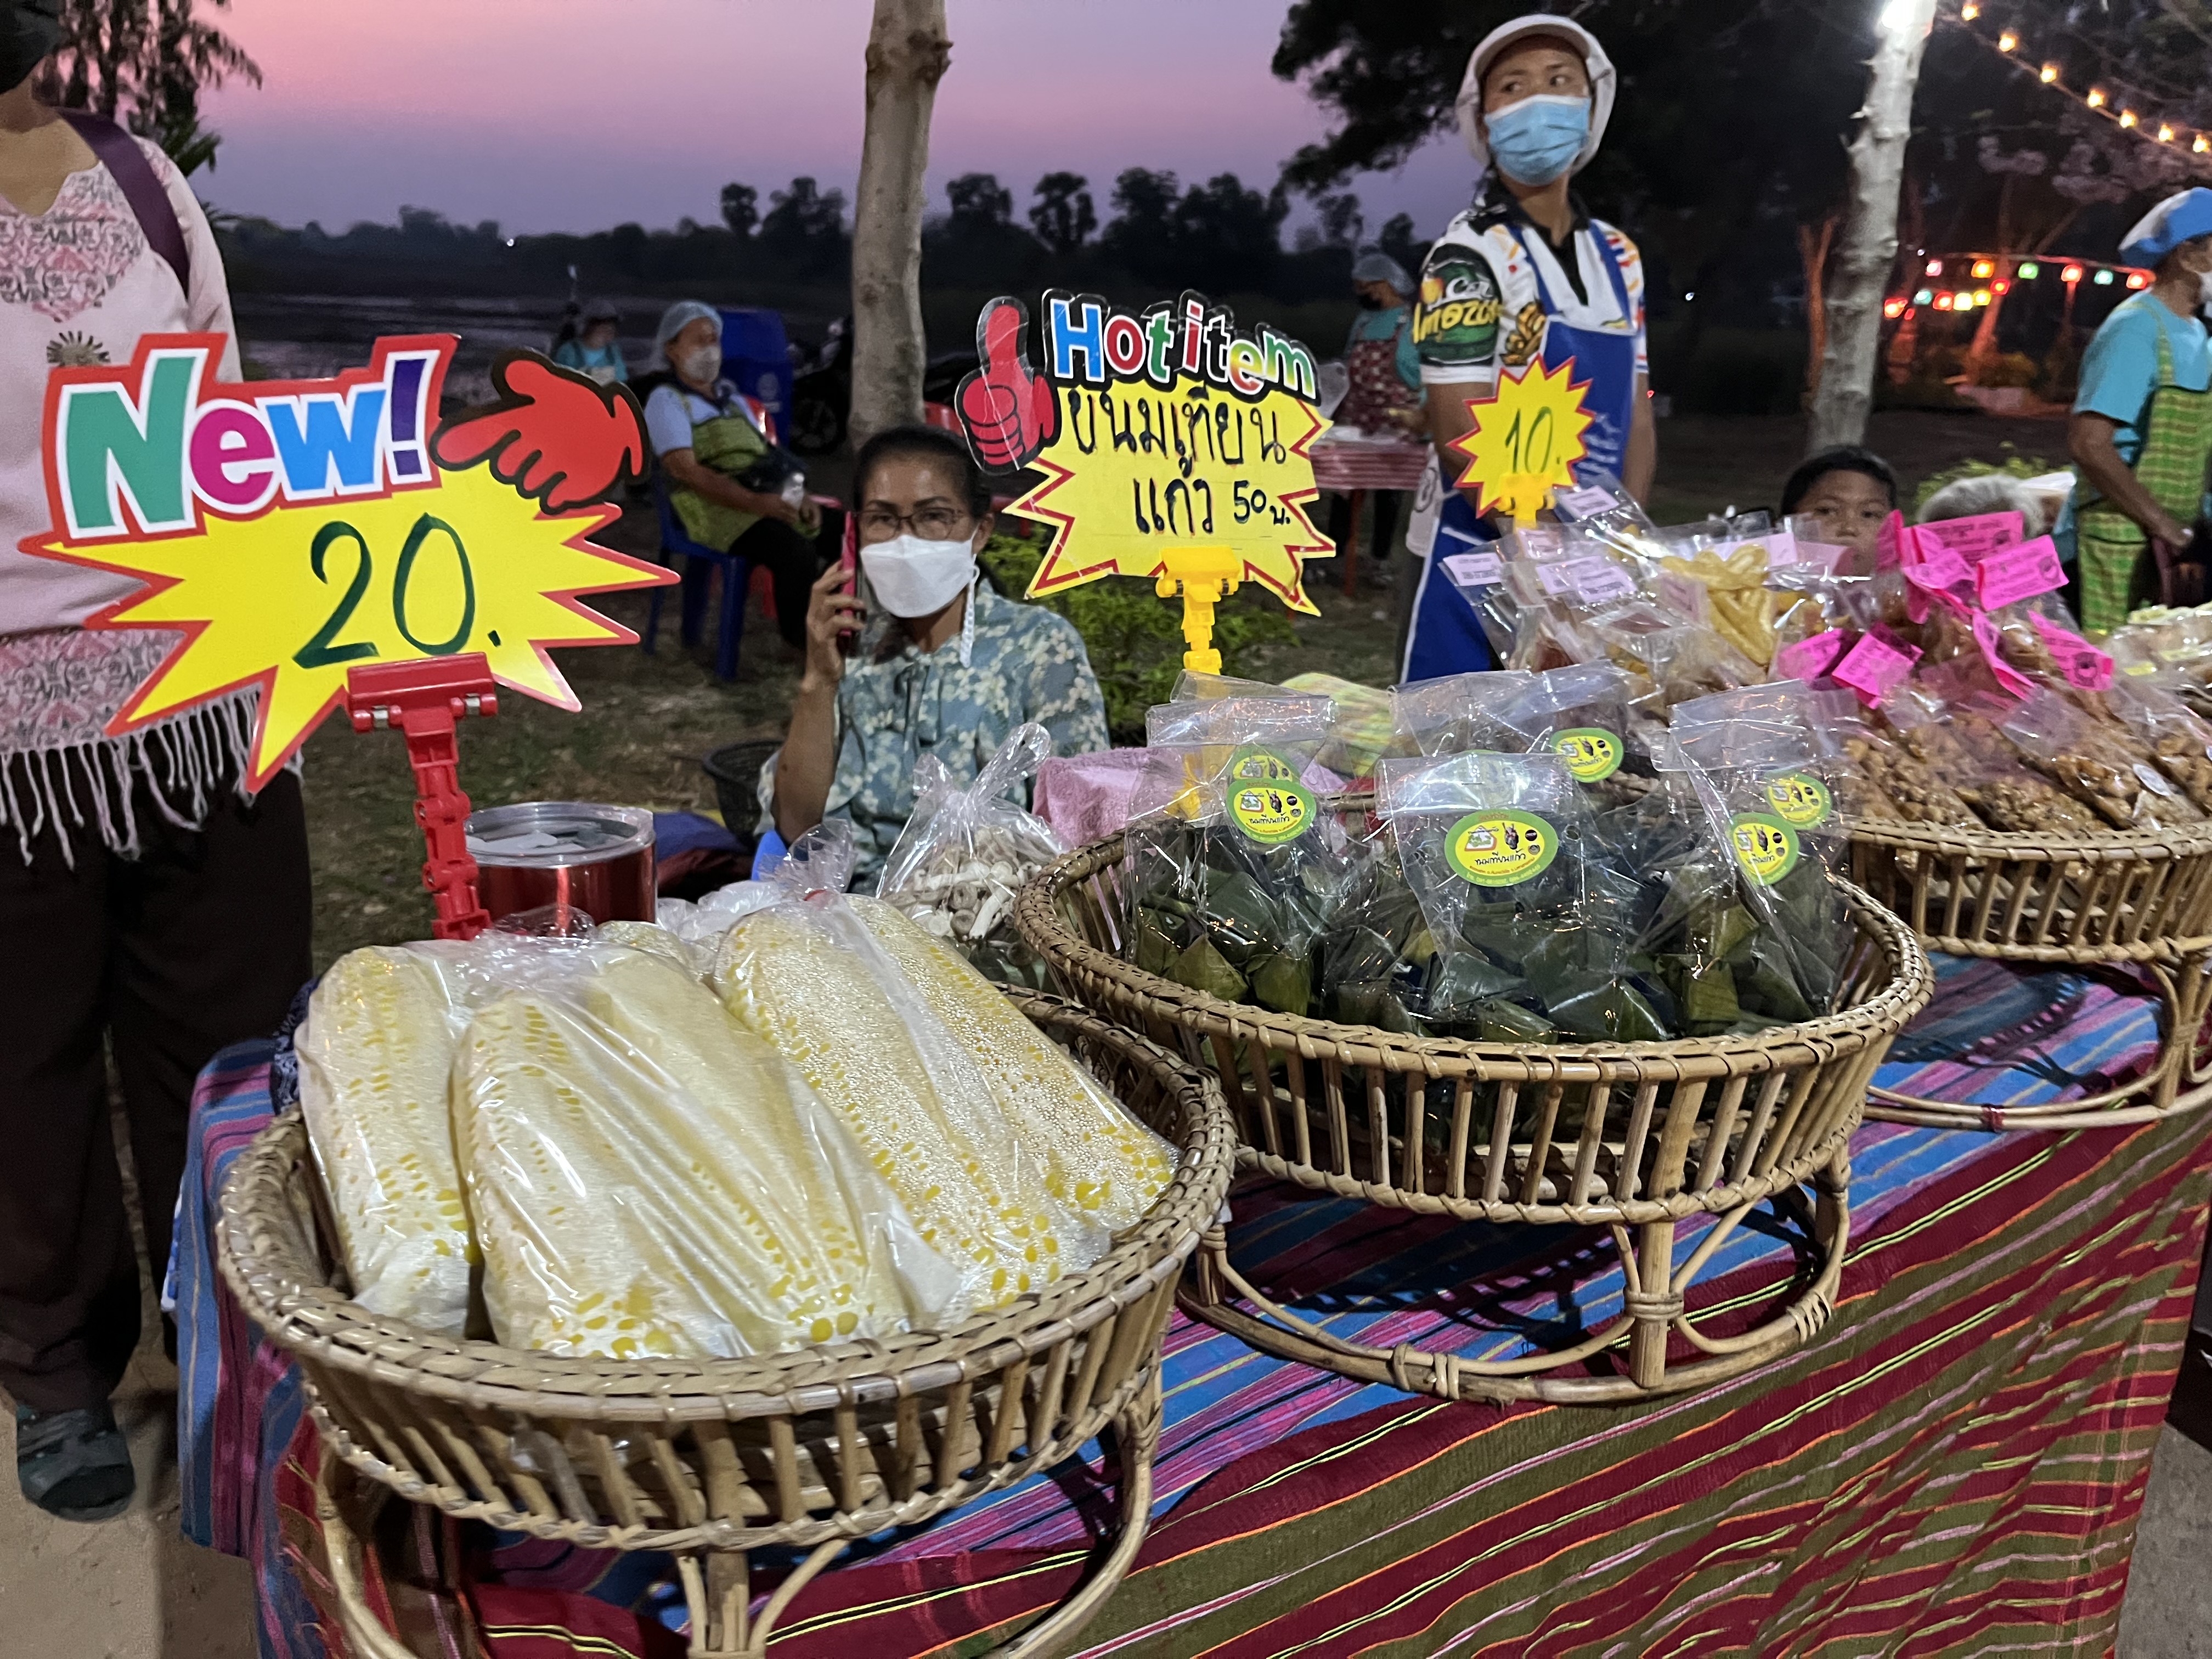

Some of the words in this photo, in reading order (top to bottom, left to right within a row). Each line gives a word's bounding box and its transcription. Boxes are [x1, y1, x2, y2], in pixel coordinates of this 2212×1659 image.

[1049, 298, 1174, 383] Hot
[1181, 298, 1316, 400] item
[58, 348, 439, 538] New!
[1133, 456, 1214, 535] แก้ว
